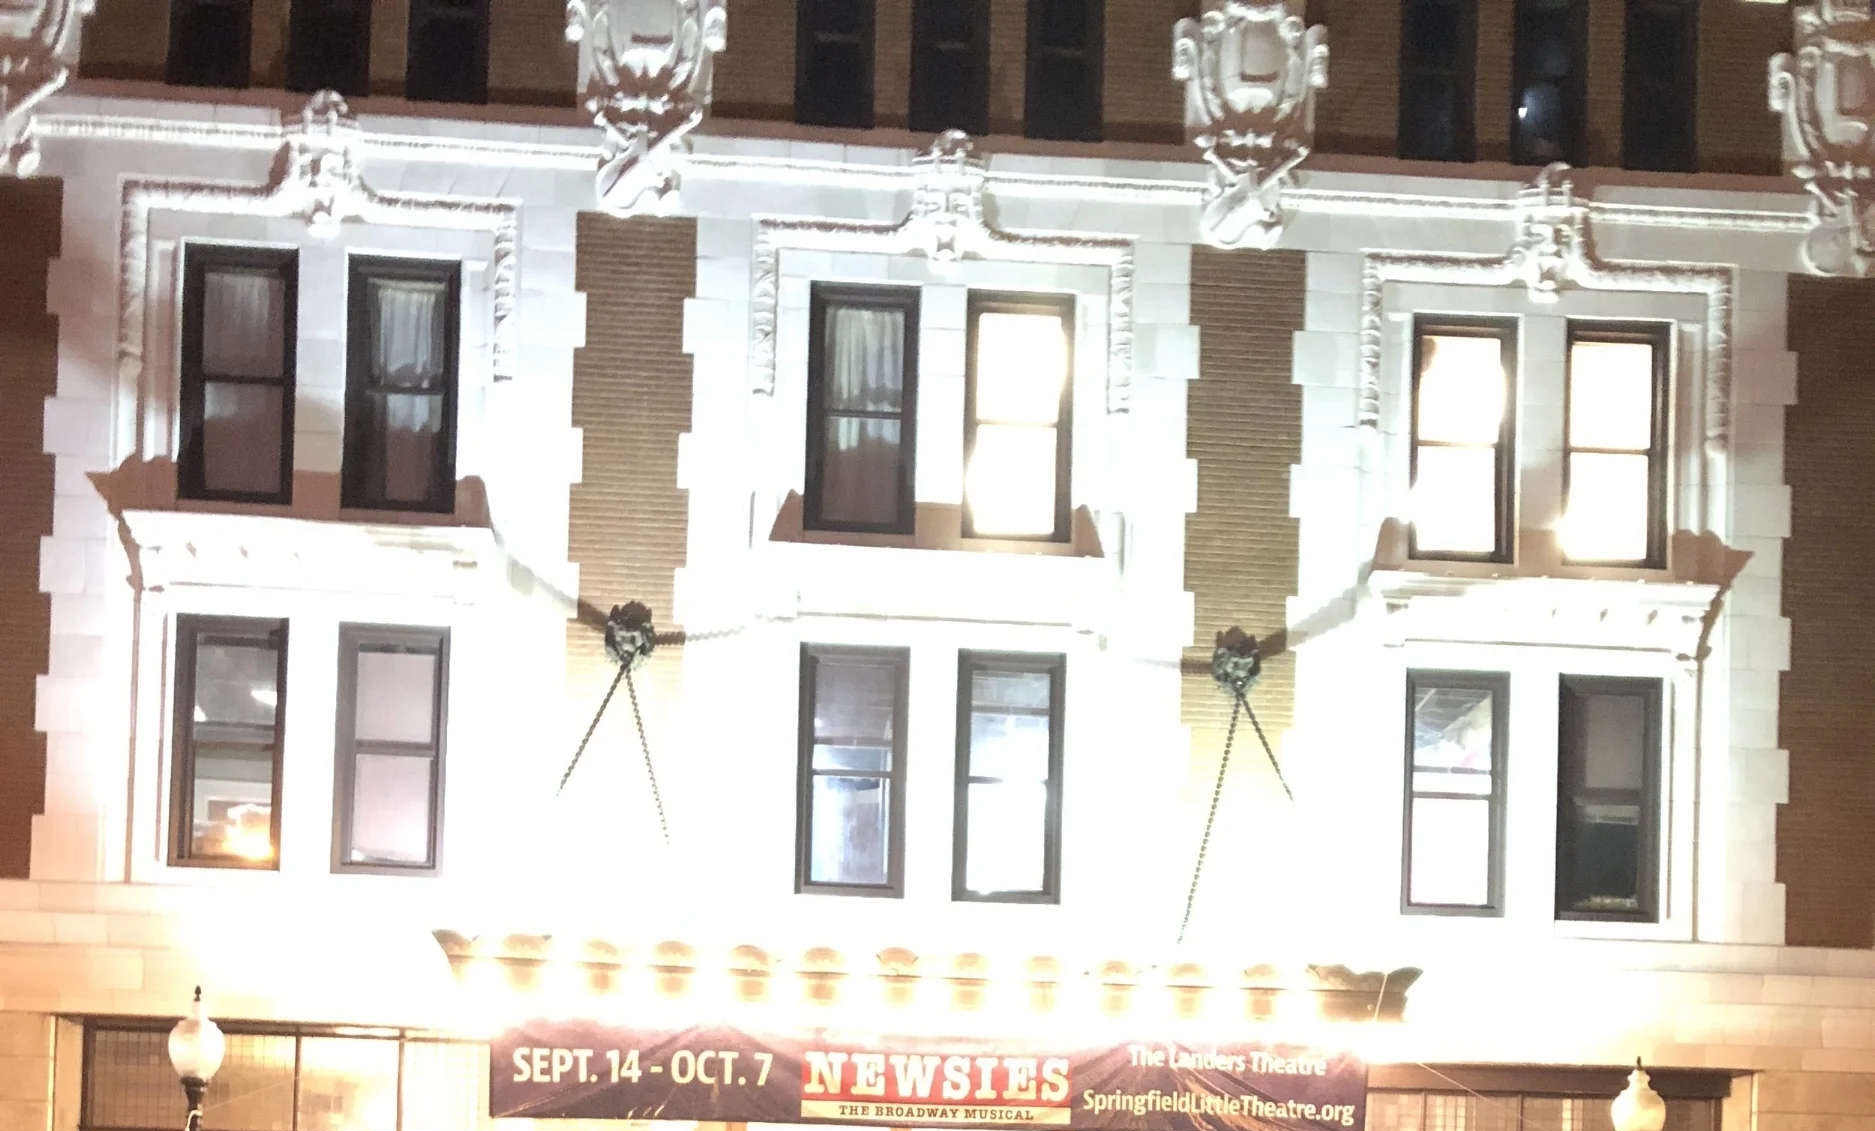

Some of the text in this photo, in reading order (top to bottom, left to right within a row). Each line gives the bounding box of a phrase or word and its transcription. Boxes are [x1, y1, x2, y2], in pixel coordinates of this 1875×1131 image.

[512, 1047, 598, 1083] SEPT.
[606, 1049, 642, 1083] 14
[671, 1049, 747, 1085] OCT.
[753, 1052, 773, 1087] 7
[803, 1050, 1070, 1102] NEWSIES
[1128, 1045, 1327, 1076] The Landers Theatre
[839, 1105, 1034, 1121] THE BROADWAY MUSICAL
[1082, 1088, 1356, 1126] SpringfieldLittleTheatre.org
